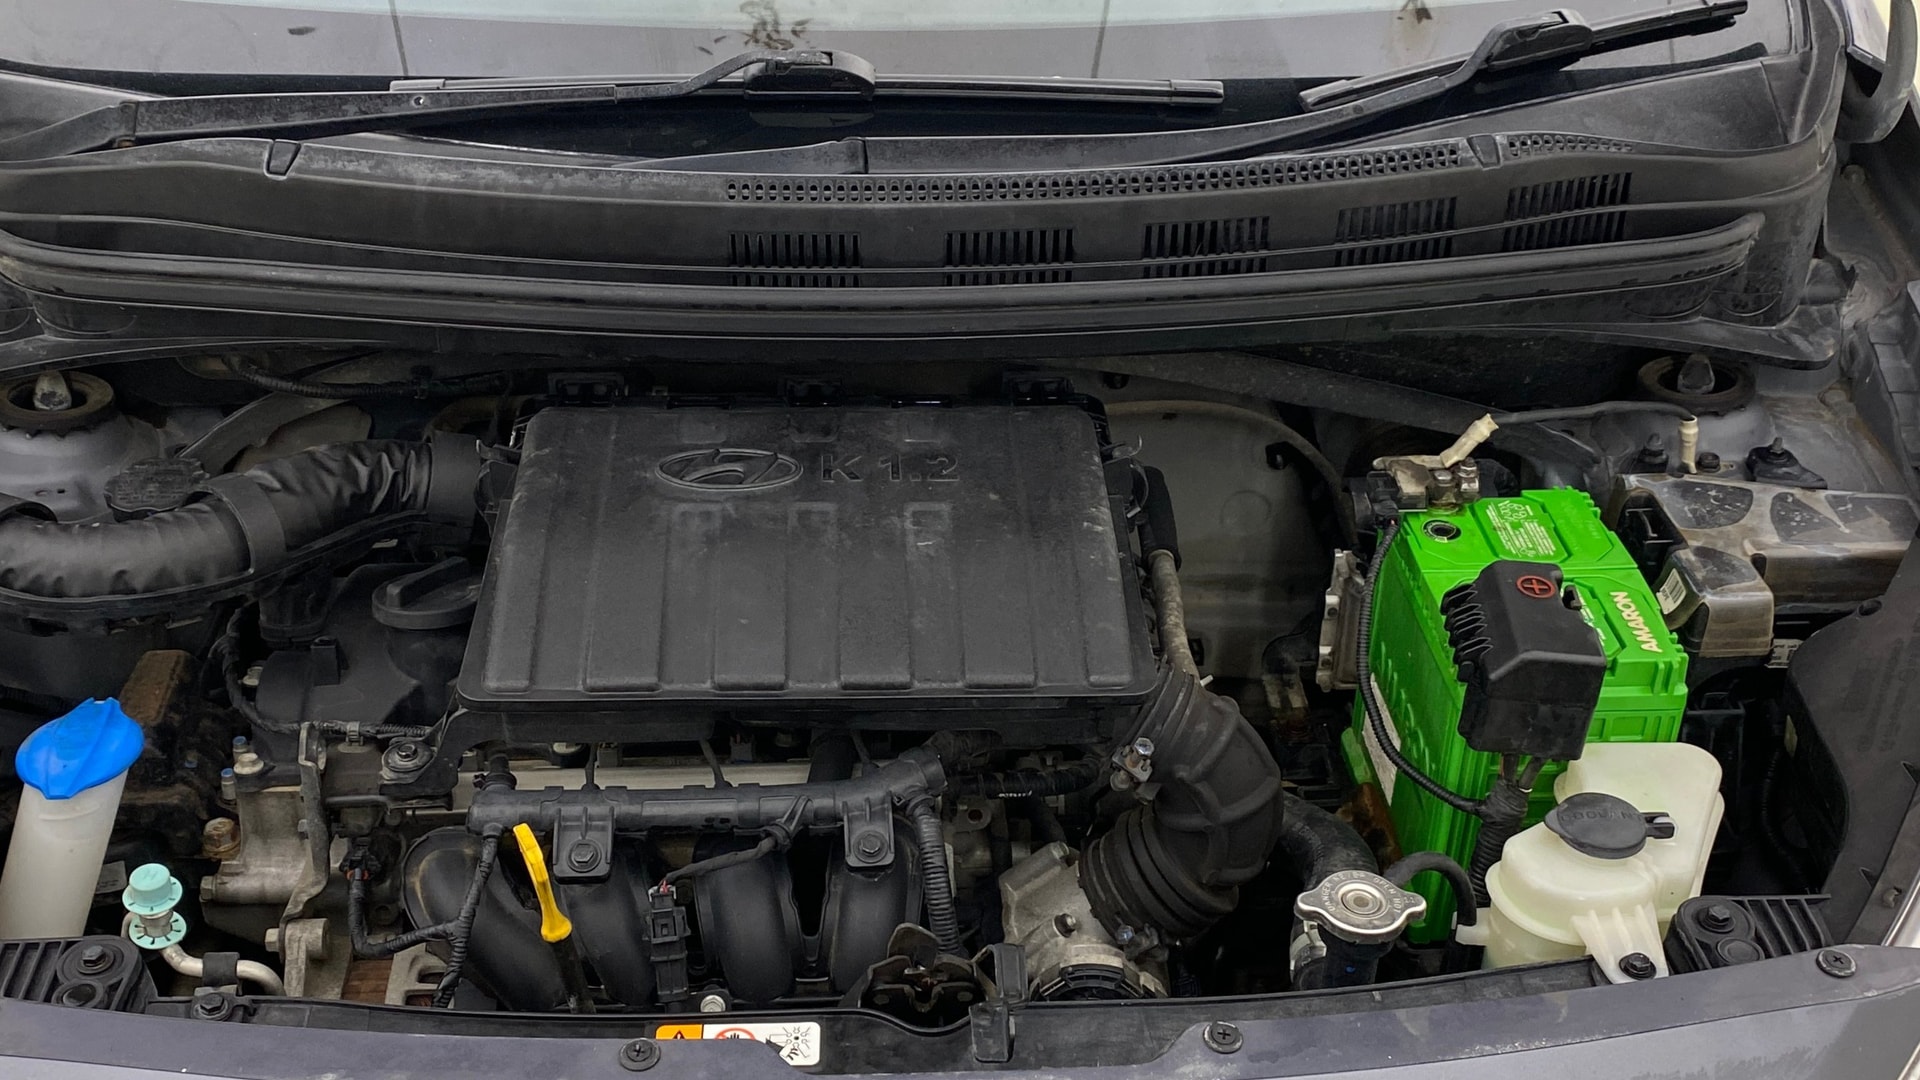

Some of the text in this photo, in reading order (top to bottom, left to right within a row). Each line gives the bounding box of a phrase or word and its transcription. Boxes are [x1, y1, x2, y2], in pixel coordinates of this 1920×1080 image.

[821, 453, 960, 483] K 1.2
[1609, 591, 1663, 653] AMARON
[1561, 808, 1642, 822] COOLANT
[1322, 881, 1335, 912] DANGER
[1373, 877, 1396, 894] OPEN
